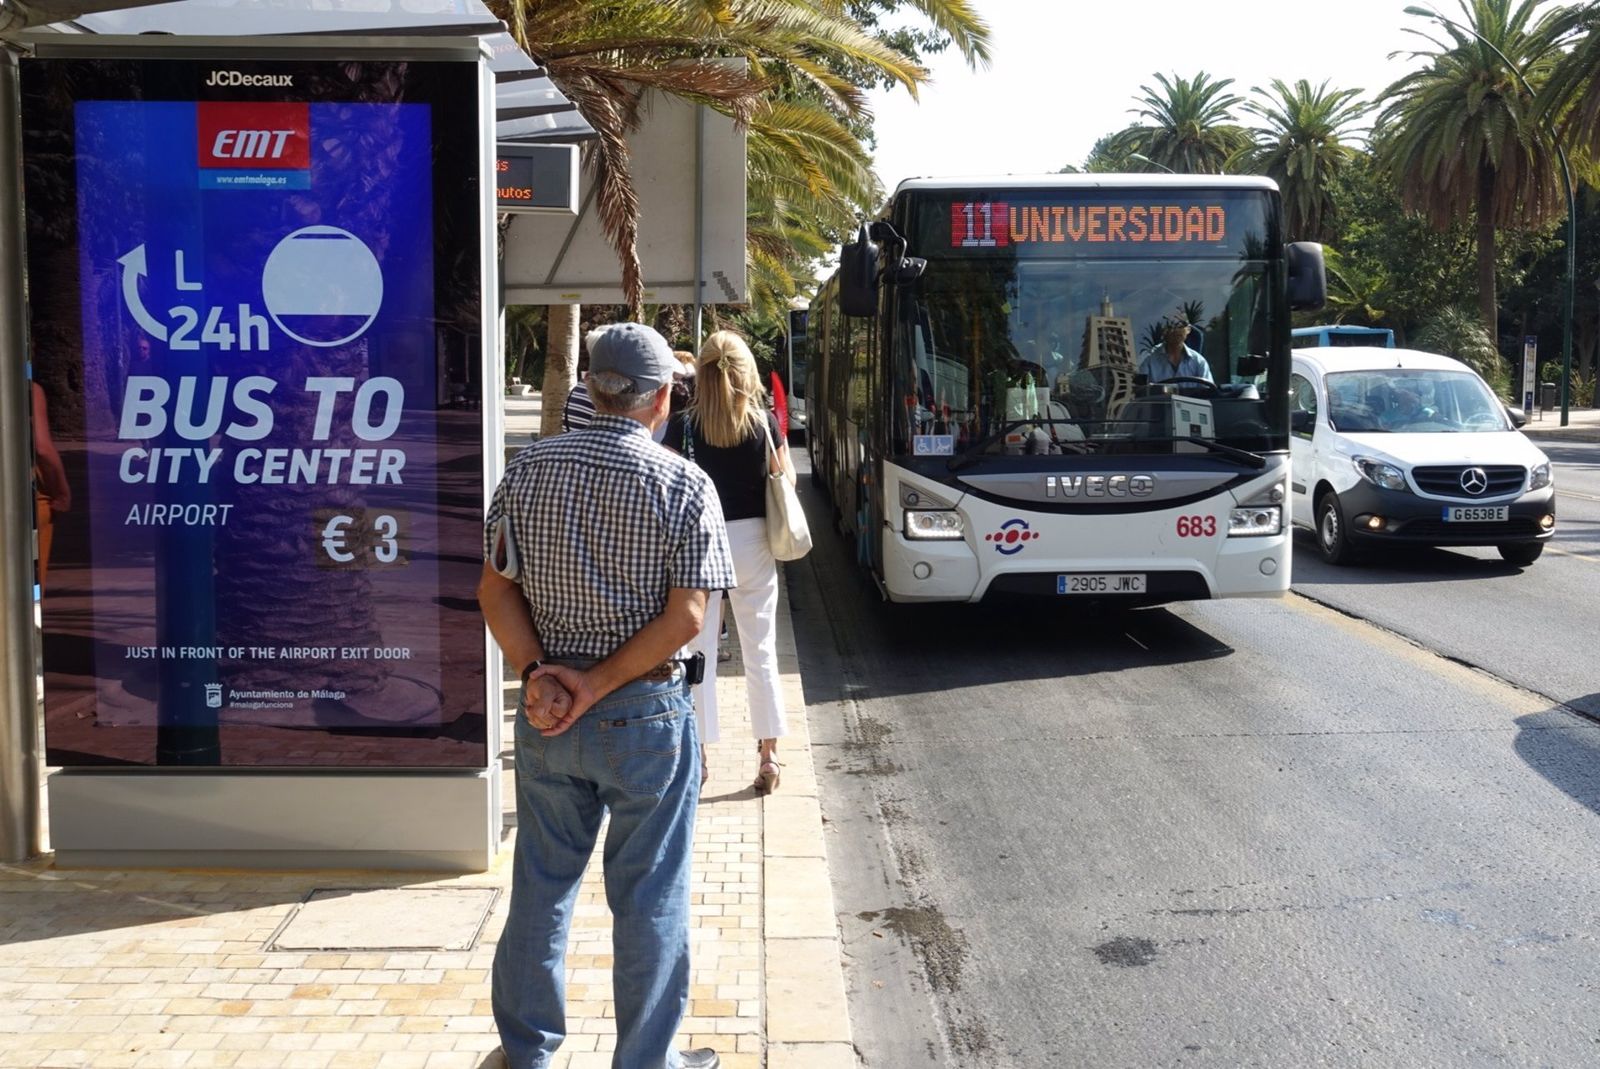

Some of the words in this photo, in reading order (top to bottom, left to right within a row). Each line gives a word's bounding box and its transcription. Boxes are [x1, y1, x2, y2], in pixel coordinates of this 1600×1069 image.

[206, 70, 293, 87] JCDecaux
[212, 130, 296, 158] EMT
[216, 174, 287, 186] www.emtmalaga.es
[962, 202, 996, 247] 11
[1010, 206, 1225, 241] UNIVERSIDAD
[175, 249, 203, 291] L
[168, 303, 270, 350] 24h
[118, 375, 278, 441] BUS
[304, 376, 405, 442] TO
[119, 447, 224, 484] CITY
[233, 448, 406, 485] CENTER
[1046, 475, 1155, 498] IVECO
[125, 504, 233, 526] AIRPORT
[1176, 515, 1217, 537] 683
[321, 515, 355, 563] €
[374, 514, 399, 564] 3
[1071, 577, 1107, 591] 2905
[1113, 577, 1140, 591] JWC
[125, 647, 157, 659] JUST
[162, 647, 176, 659] IN
[180, 647, 224, 659] FRONT
[228, 647, 245, 659] OF
[249, 647, 276, 659] THE
[279, 647, 337, 659] AIRPORT
[341, 648, 369, 659] EXIT
[374, 648, 411, 659] DOOR
[229, 689, 294, 699] Ayuntamiento
[297, 690, 309, 699] de
[311, 689, 346, 700] Málaga
[229, 701, 293, 709] #malagafunciona
